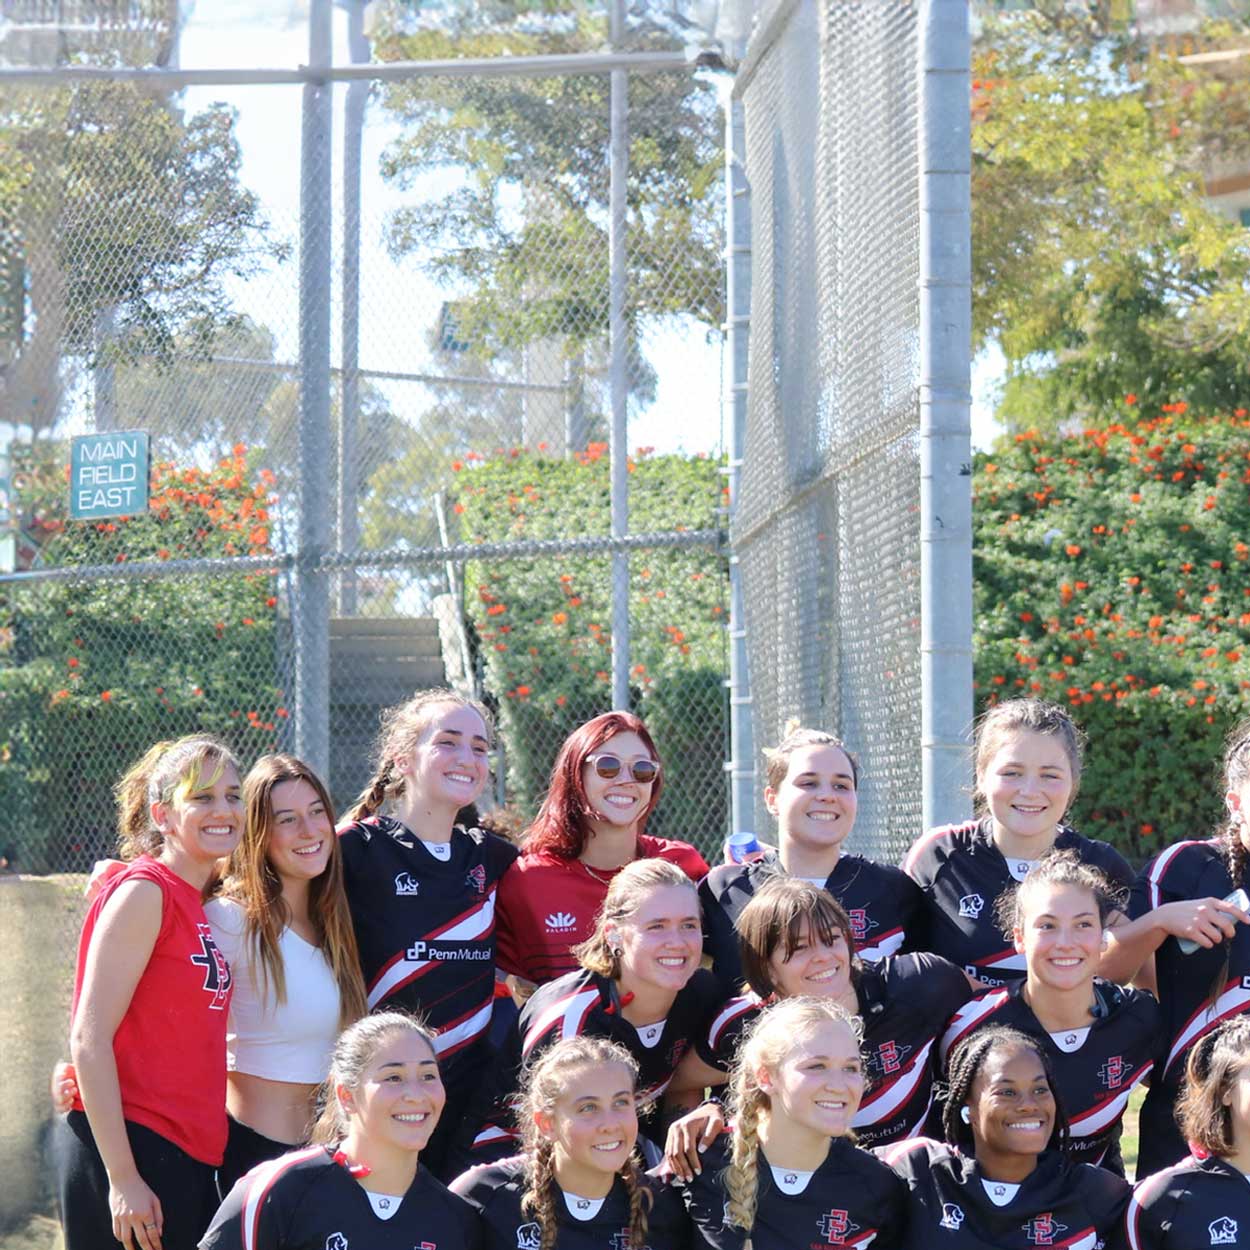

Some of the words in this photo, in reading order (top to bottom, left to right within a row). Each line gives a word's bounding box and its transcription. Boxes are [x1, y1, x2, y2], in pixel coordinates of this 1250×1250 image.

[79, 440, 137, 462] MAIN
[79, 463, 136, 485] FIELD
[78, 486, 137, 510] EAST
[428, 946, 492, 961] PennMutual
